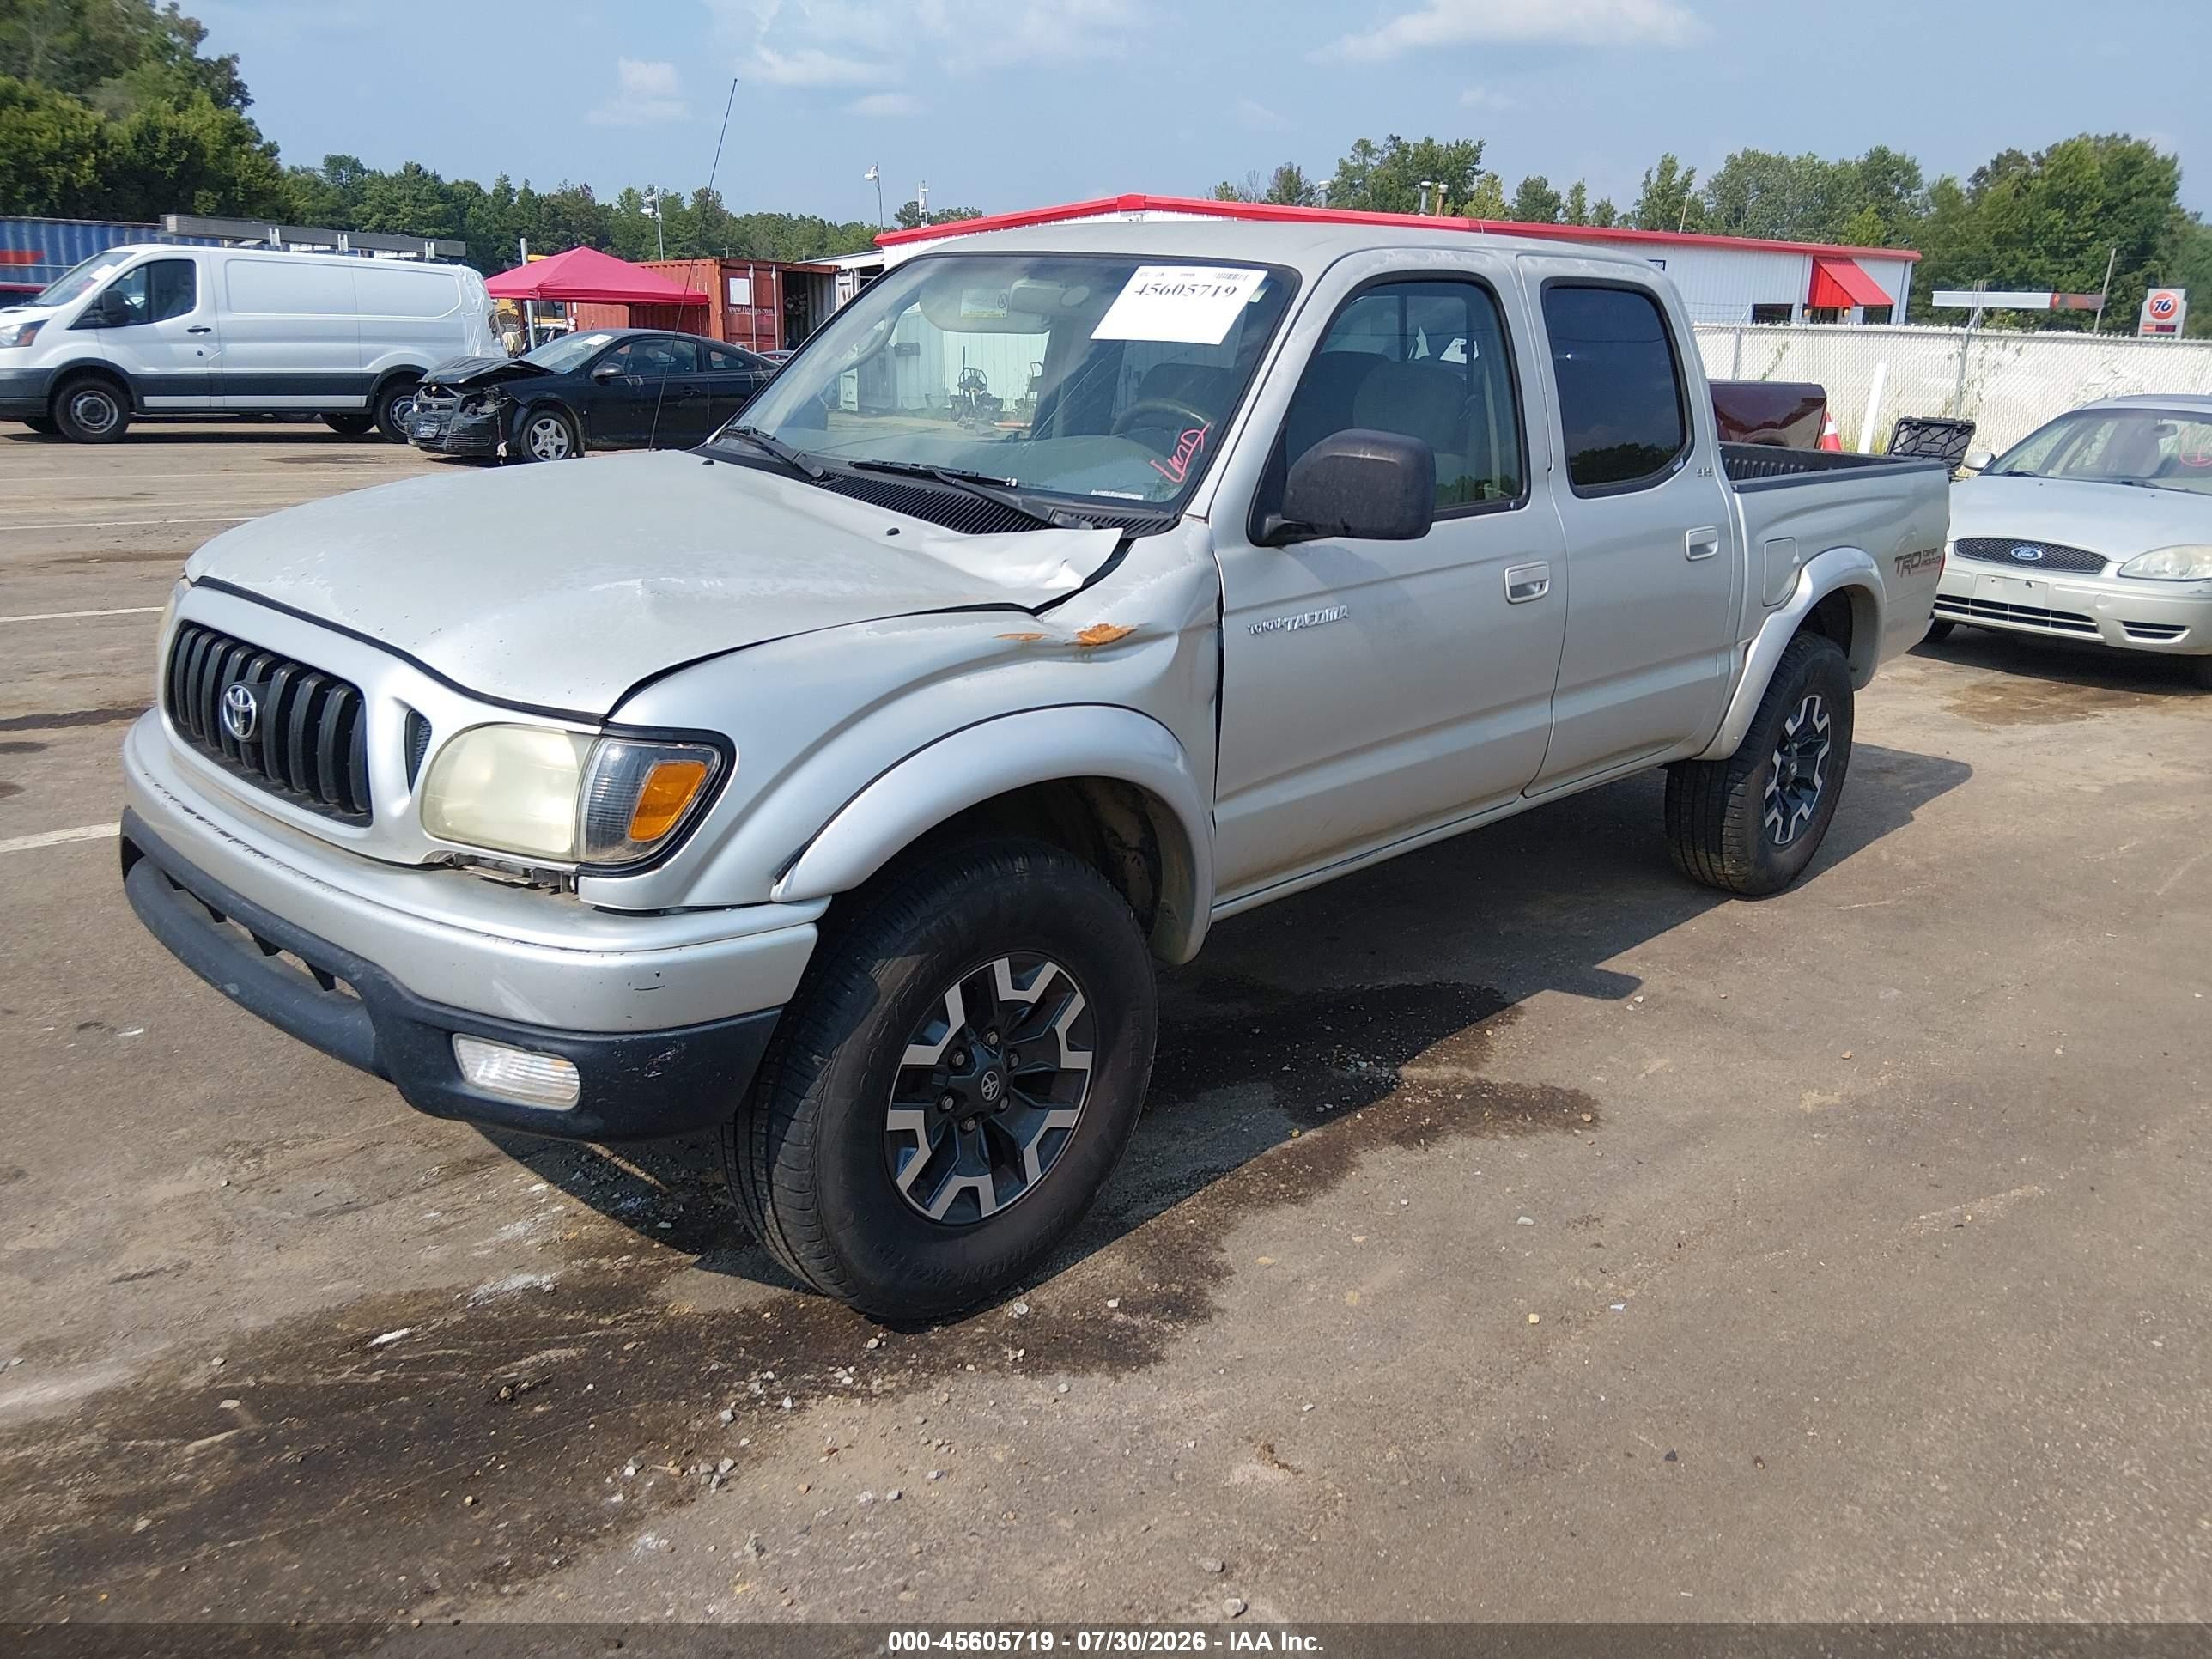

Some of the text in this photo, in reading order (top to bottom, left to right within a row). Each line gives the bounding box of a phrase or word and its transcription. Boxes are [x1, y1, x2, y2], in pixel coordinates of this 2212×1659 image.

[1134, 283, 1237, 298] 45605719
[2154, 299, 2172, 312] 76
[1894, 550, 1922, 578] TRD
[1283, 605, 1348, 631] TACOMA
